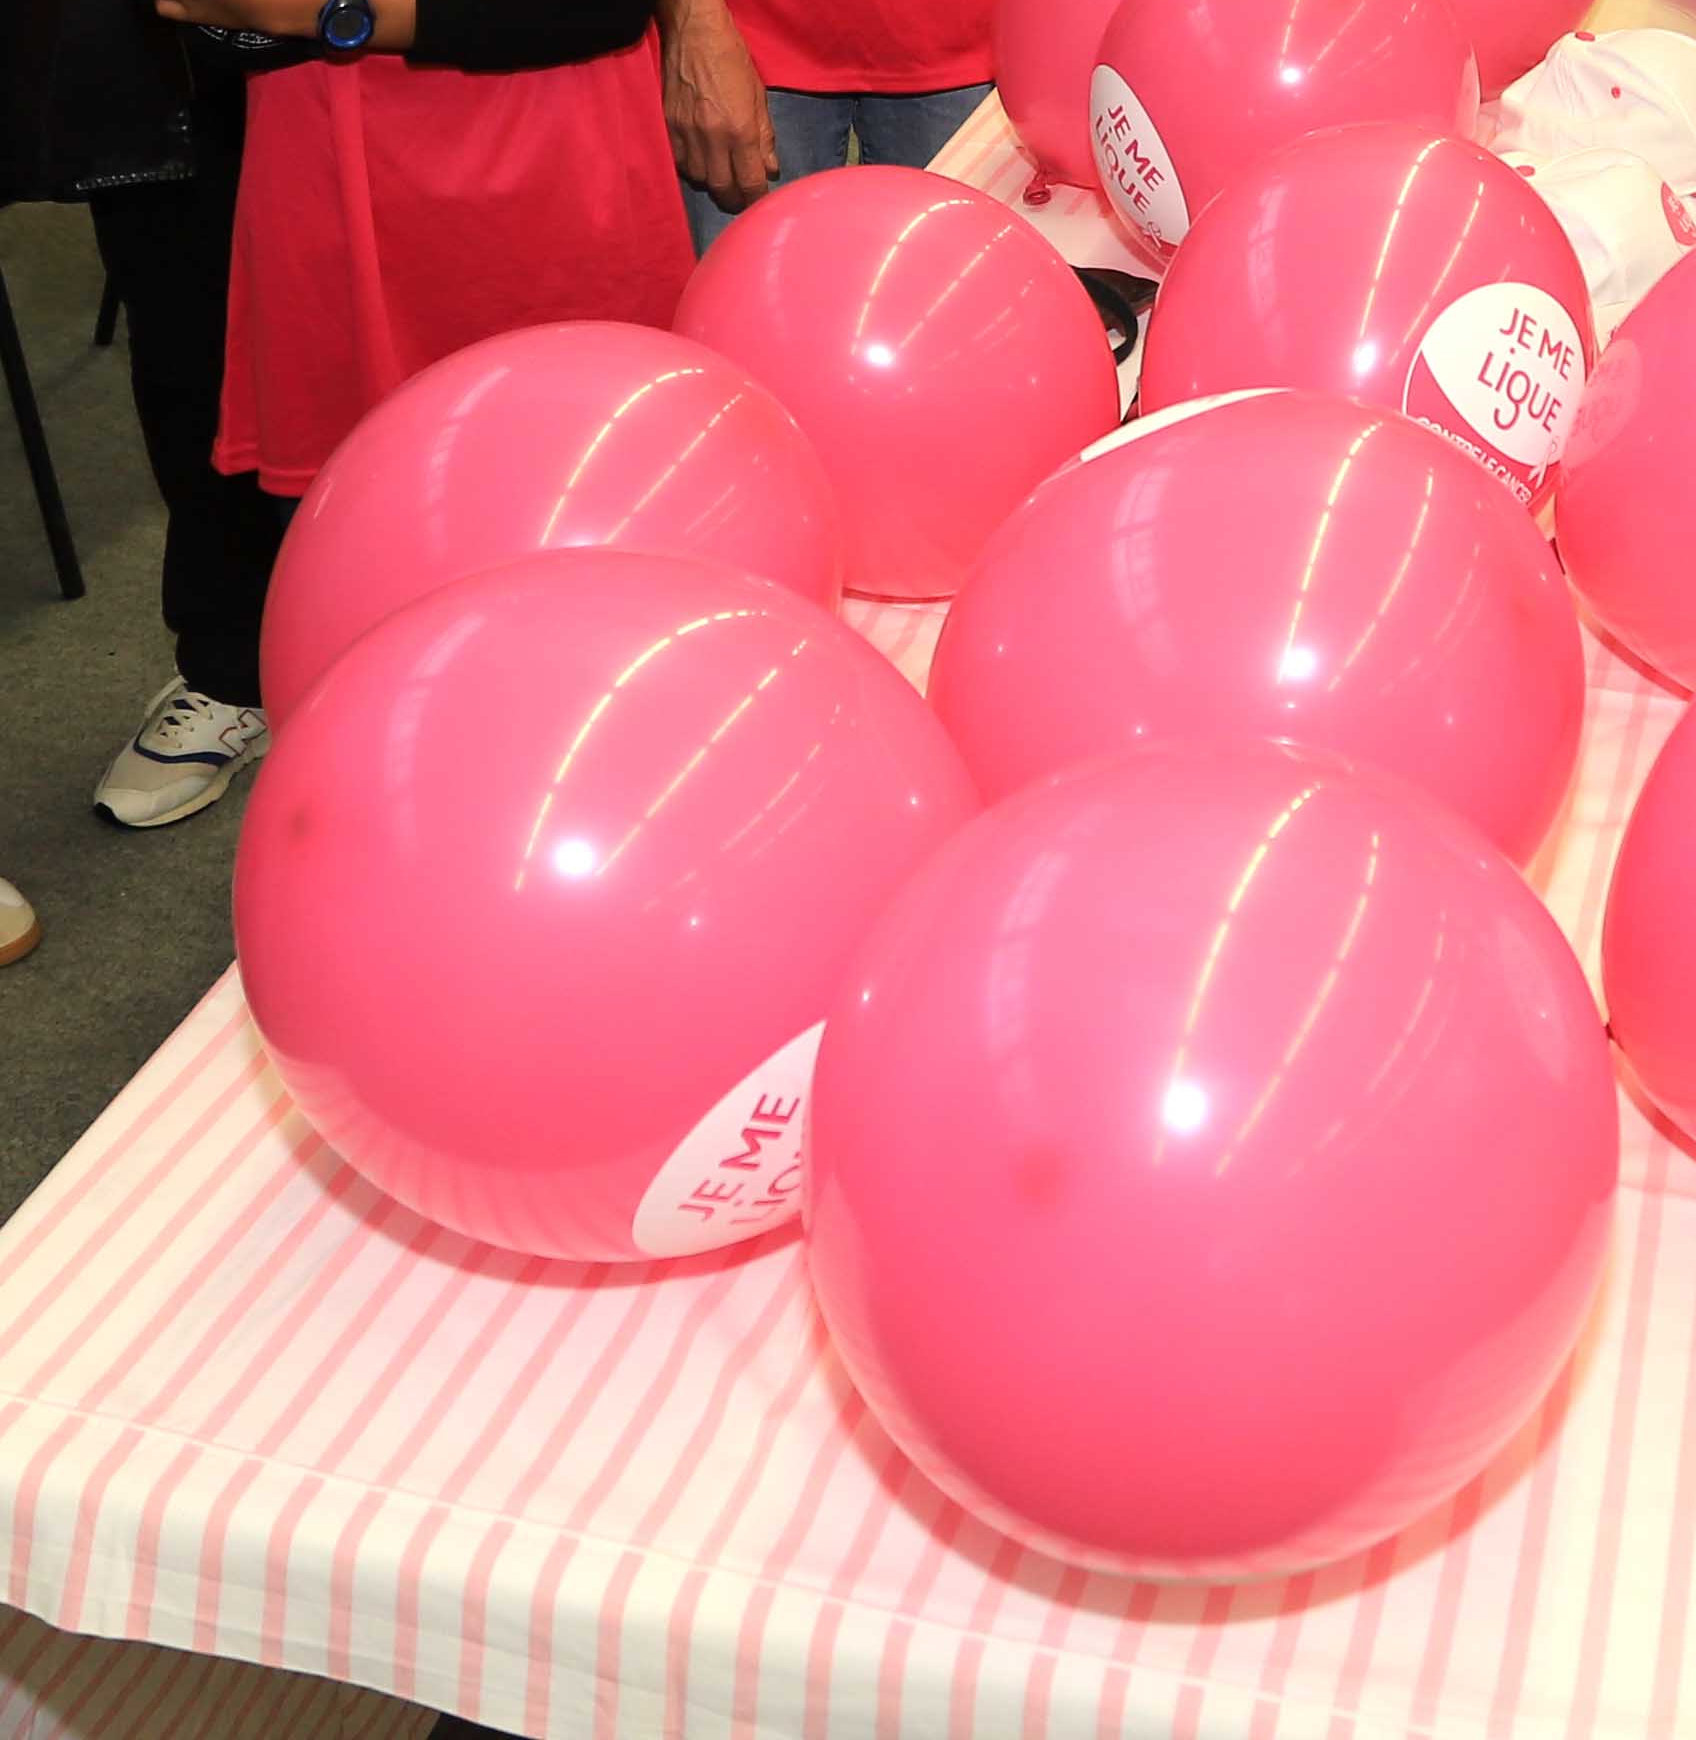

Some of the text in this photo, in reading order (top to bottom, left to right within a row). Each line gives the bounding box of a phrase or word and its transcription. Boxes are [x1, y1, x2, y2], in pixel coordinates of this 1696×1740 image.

[1107, 104, 1165, 193] JE ME
[1499, 307, 1575, 381] JE ME
[677, 1092, 801, 1222] JE ME
